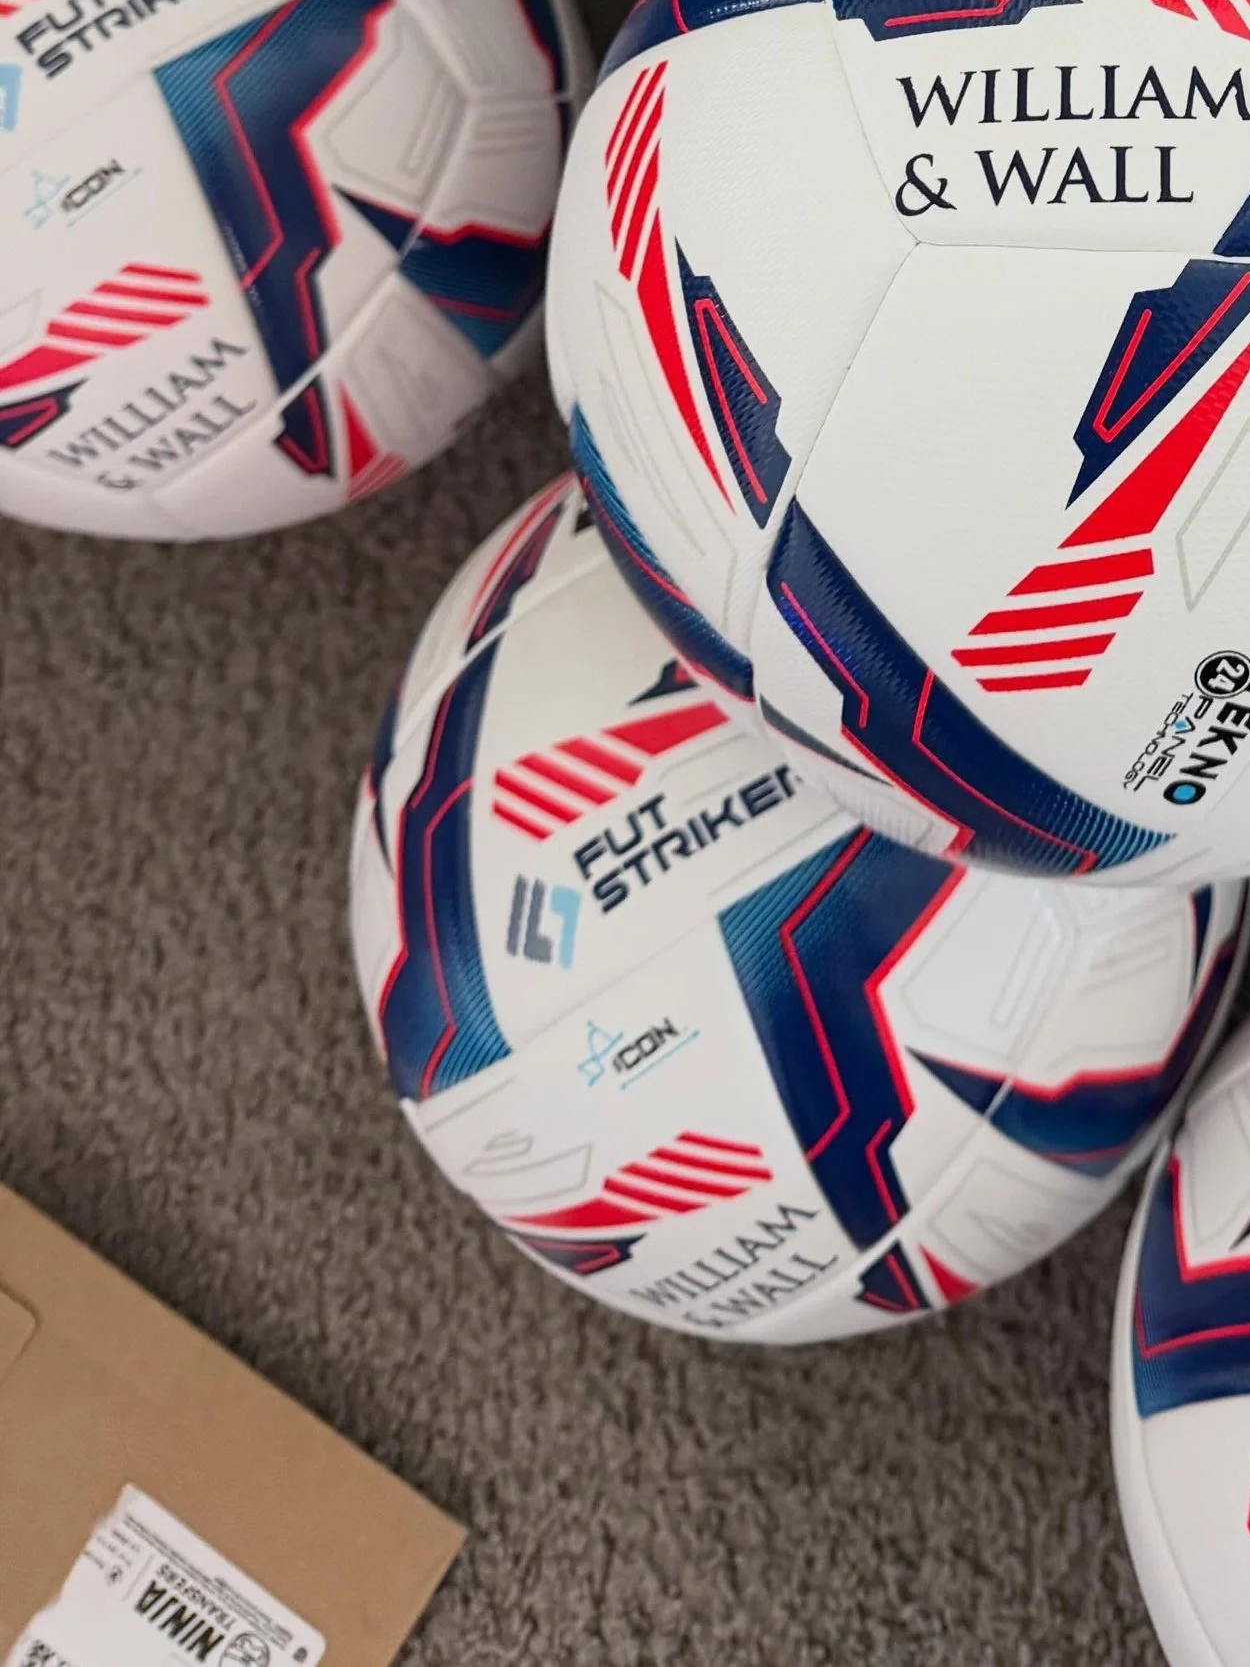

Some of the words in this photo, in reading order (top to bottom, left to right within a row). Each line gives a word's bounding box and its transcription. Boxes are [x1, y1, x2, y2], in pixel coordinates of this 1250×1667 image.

[895, 152, 958, 217] &
[974, 145, 1195, 207] WALL
[47, 336, 250, 468] WILLIAM
[126, 393, 258, 472] WALL
[572, 790, 667, 881] FUT
[592, 762, 799, 915] STRIKE
[629, 1201, 819, 1308] WILLIAM
[709, 1253, 840, 1317] WALL
[134, 1579, 225, 1662] NINJA
[156, 1563, 237, 1632] TRANSFERS
